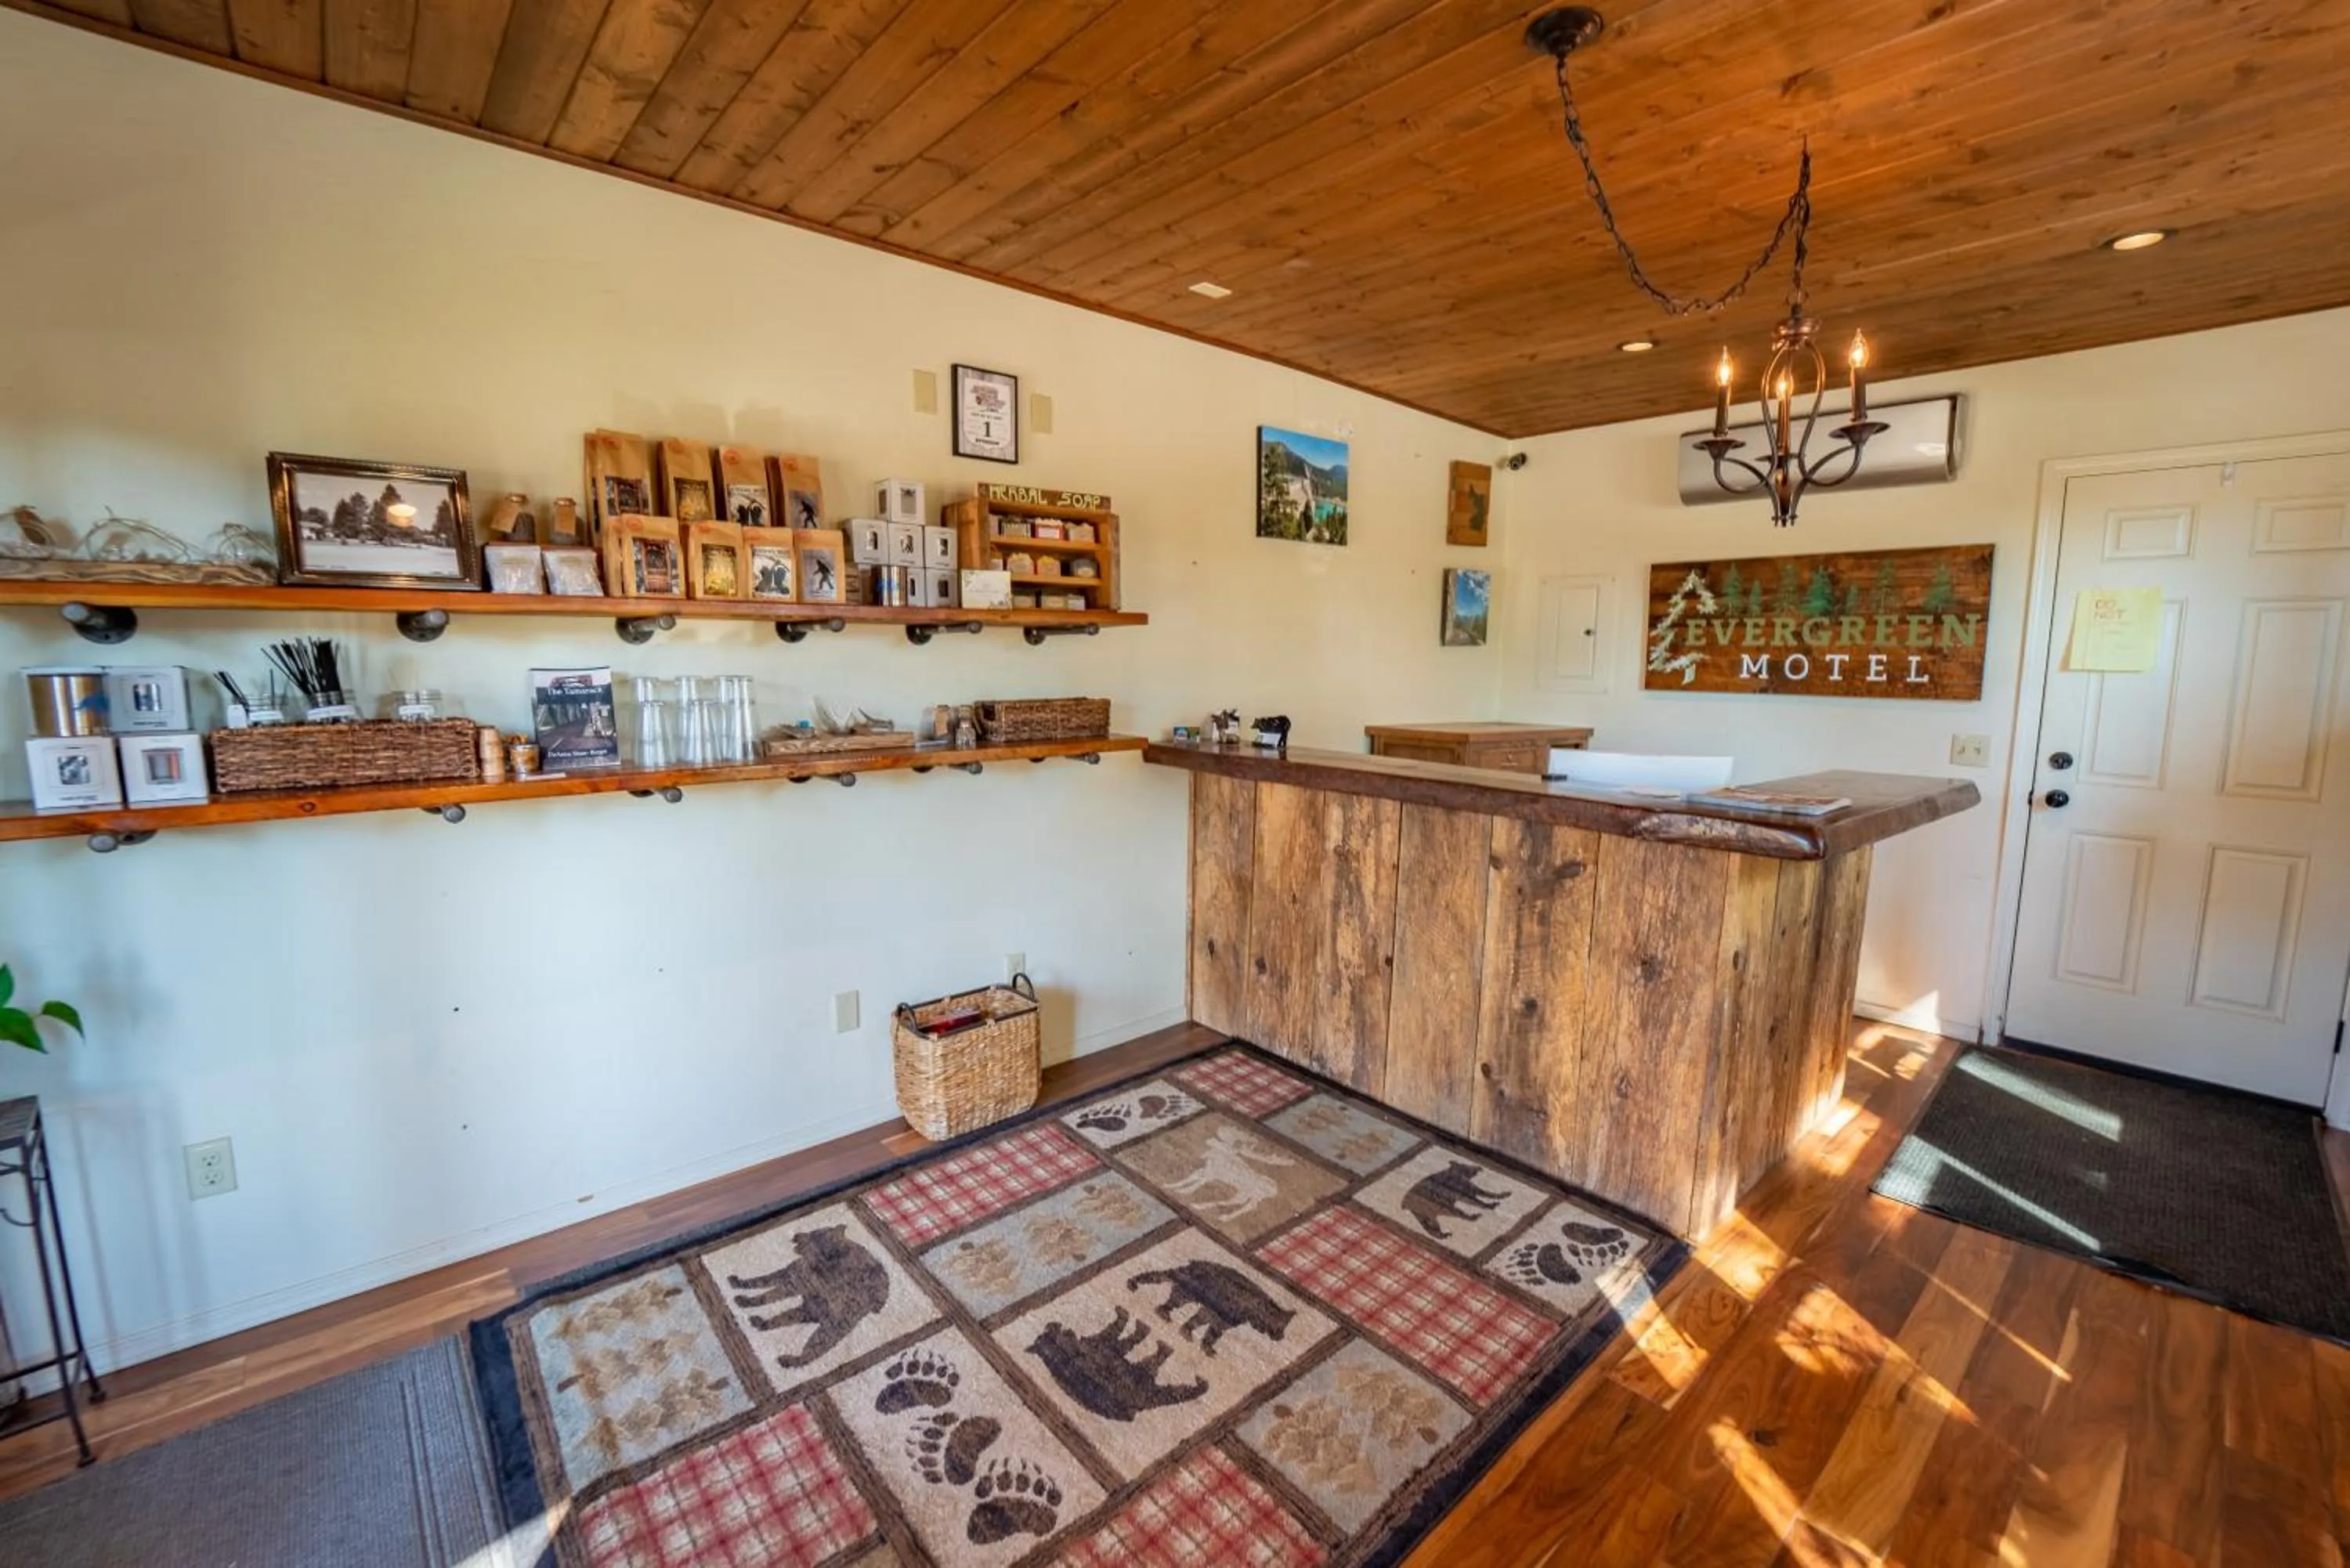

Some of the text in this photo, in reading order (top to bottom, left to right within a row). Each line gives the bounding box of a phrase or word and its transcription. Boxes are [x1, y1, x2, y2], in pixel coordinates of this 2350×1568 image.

[983, 421, 991, 438] 1
[989, 485, 1101, 509] HERBAL SOAP
[1684, 613, 1981, 648] EVERGREEN
[1739, 653, 1929, 683] MOTEL
[548, 688, 562, 696] The
